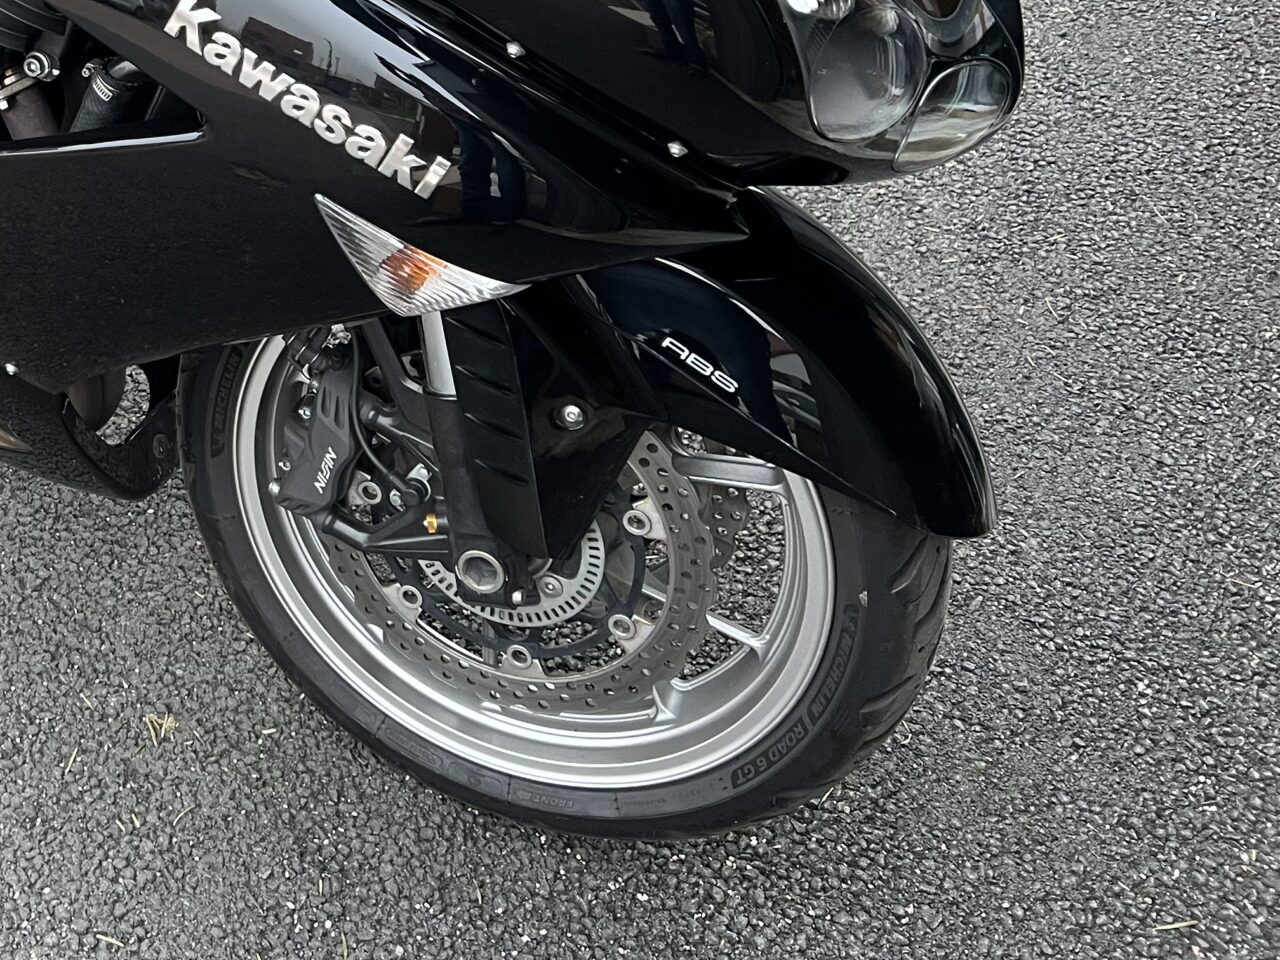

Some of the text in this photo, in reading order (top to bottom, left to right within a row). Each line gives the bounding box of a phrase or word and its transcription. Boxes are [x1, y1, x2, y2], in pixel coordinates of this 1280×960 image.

[213, 352, 240, 429] MICHELIN
[661, 336, 739, 393] ABS
[313, 445, 338, 495] NISSIN
[811, 631, 853, 719] MICHELIN
[737, 723, 805, 785] ROAD 6 GT
[532, 795, 574, 808] FRONT
